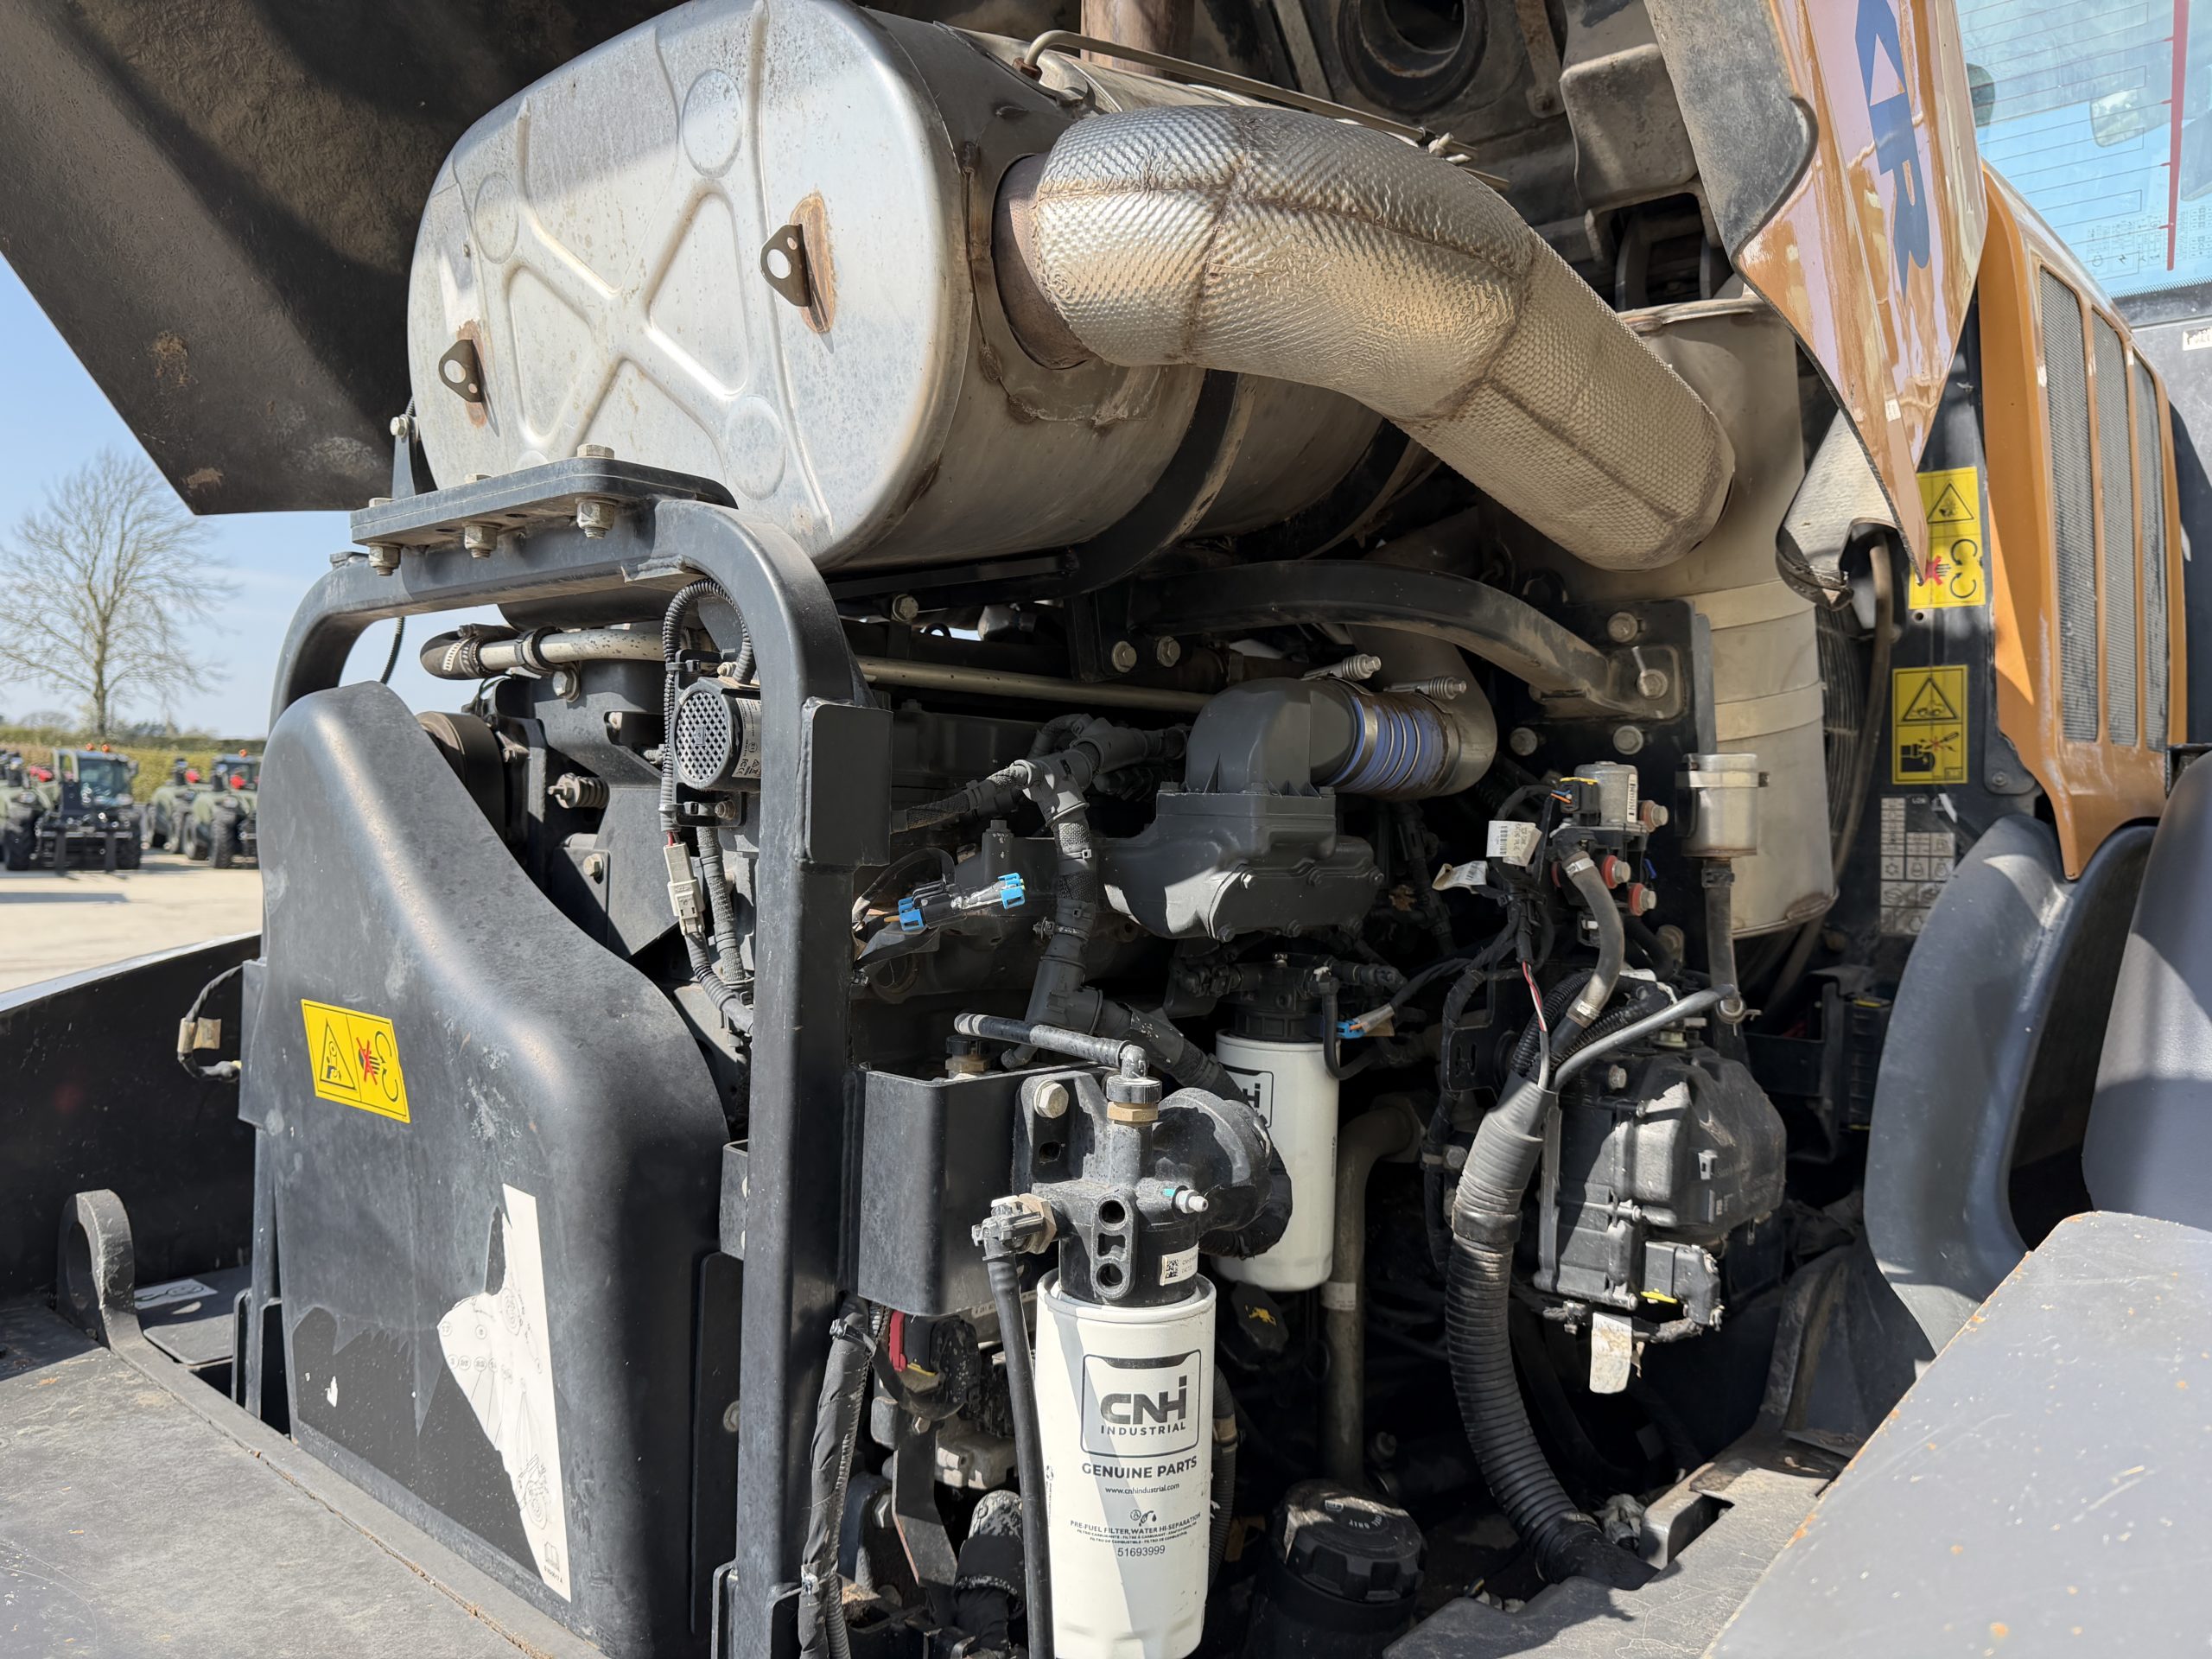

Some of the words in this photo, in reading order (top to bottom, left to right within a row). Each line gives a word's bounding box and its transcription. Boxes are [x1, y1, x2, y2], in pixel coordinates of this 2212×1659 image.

[1101, 1421, 1186, 1436] INDUSTRIAL
[1082, 1462, 1153, 1479] GENUINE
[1157, 1455, 1198, 1478] PARTS
[1105, 1483, 1180, 1495] www.cnhindustrial.com
[1070, 1520, 1103, 1533] PRE-FUEL
[1159, 1511, 1202, 1532] HI-SEPARATION
[1117, 1544, 1166, 1557] 51693999
